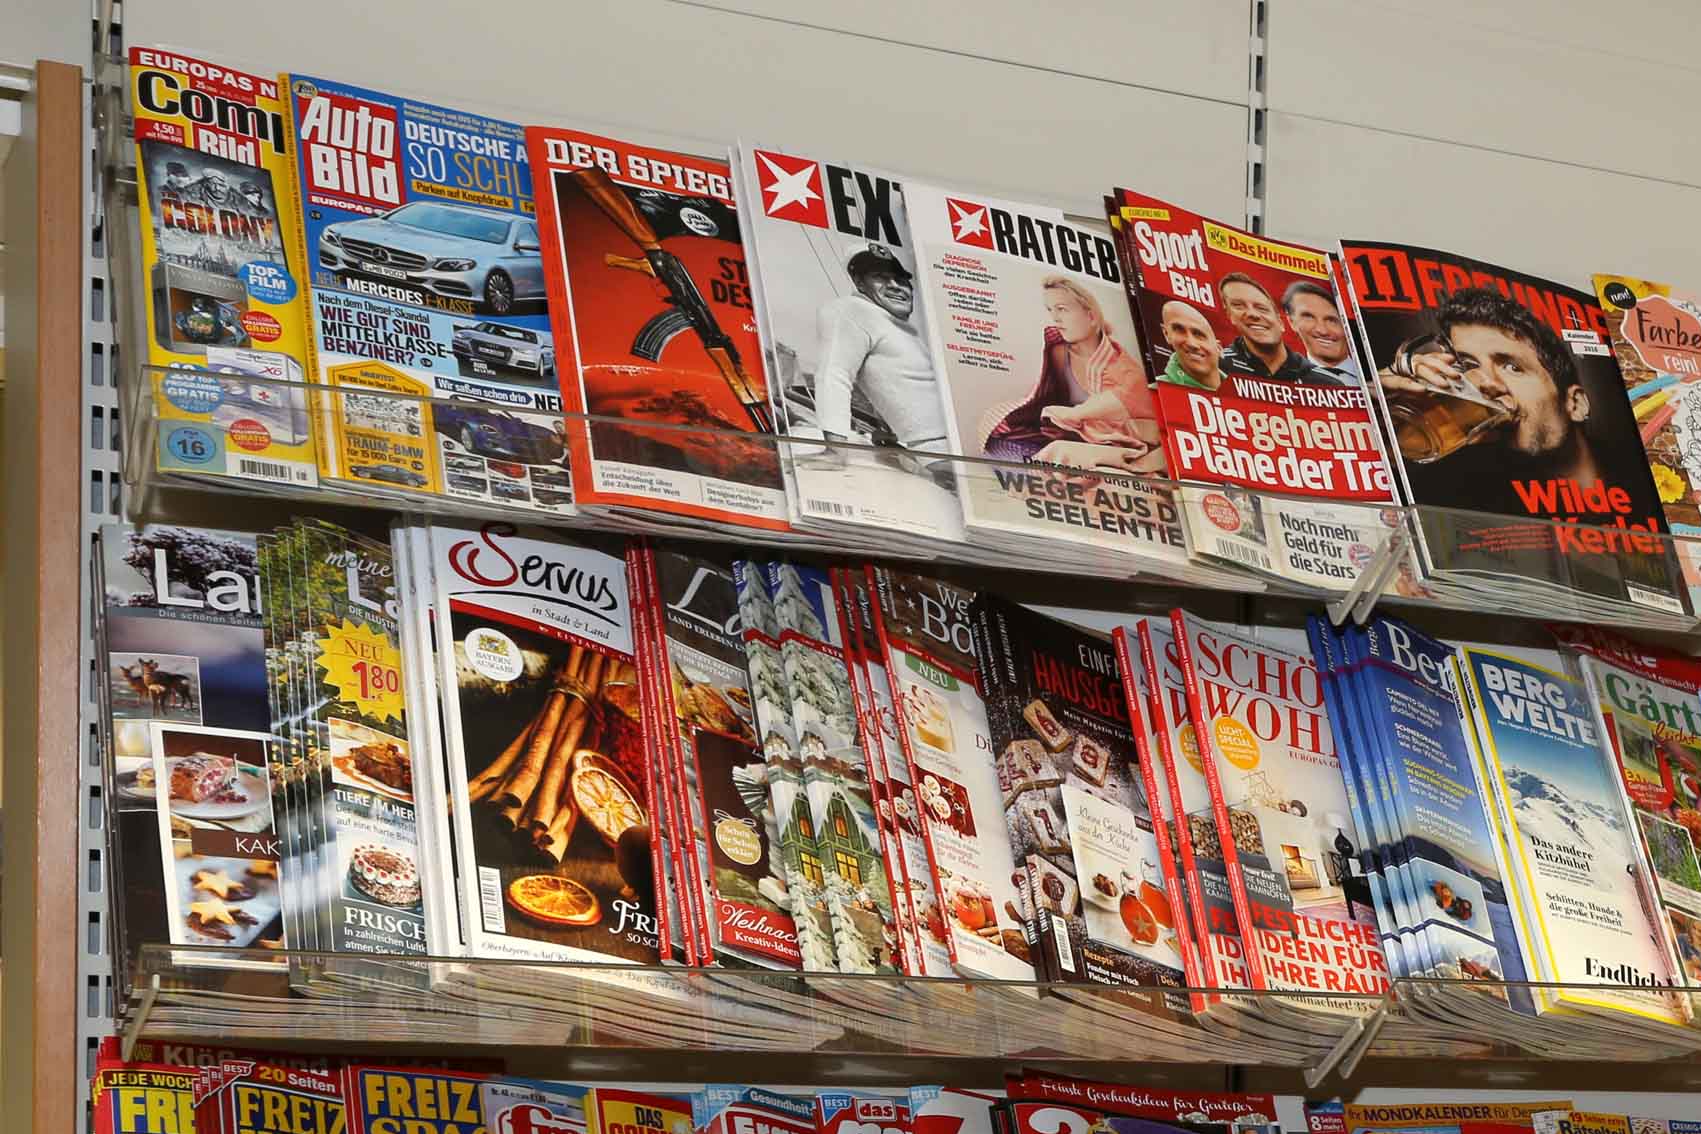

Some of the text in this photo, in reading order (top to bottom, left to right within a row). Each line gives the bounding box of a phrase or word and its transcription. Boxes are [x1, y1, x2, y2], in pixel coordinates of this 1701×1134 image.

[139, 51, 252, 92] EUROPAS
[302, 97, 397, 158] Auto
[404, 122, 511, 159] DEUTSCHE
[197, 128, 259, 167] Bild
[310, 145, 401, 204] Bild
[1134, 221, 1208, 273] Sport
[1227, 236, 1328, 274] Das Hummels
[249, 274, 287, 292] FILM
[347, 279, 423, 304] MERCEDES
[1171, 274, 1214, 309] Bild
[320, 306, 431, 340] WIE GUT SIND
[324, 338, 414, 365] BENZINER?
[1664, 356, 1699, 374] rein!
[1189, 394, 1247, 439] Die
[175, 436, 205, 457] 16
[995, 469, 1151, 518] WEGE AUS
[1511, 479, 1632, 516] Wilde
[1284, 532, 1342, 559] Geld für
[1552, 515, 1665, 556] Kerle!
[448, 520, 618, 611] Servus
[1290, 553, 1356, 580] die Stars
[918, 661, 949, 687] NEU
[1483, 663, 1566, 708] BERG
[1530, 836, 1594, 861] Das andere
[1535, 850, 1591, 872] Kitzbühel
[1254, 903, 1376, 946] FESTLICHE
[1259, 930, 1383, 971] IDEEN FÜR
[1263, 956, 1322, 983] IHRE
[109, 1073, 147, 1088] JEDE
[259, 1066, 335, 1094] 20 Seiten
[634, 1108, 663, 1129] DAS
[1363, 1105, 1490, 1122] MONDKALENDER
